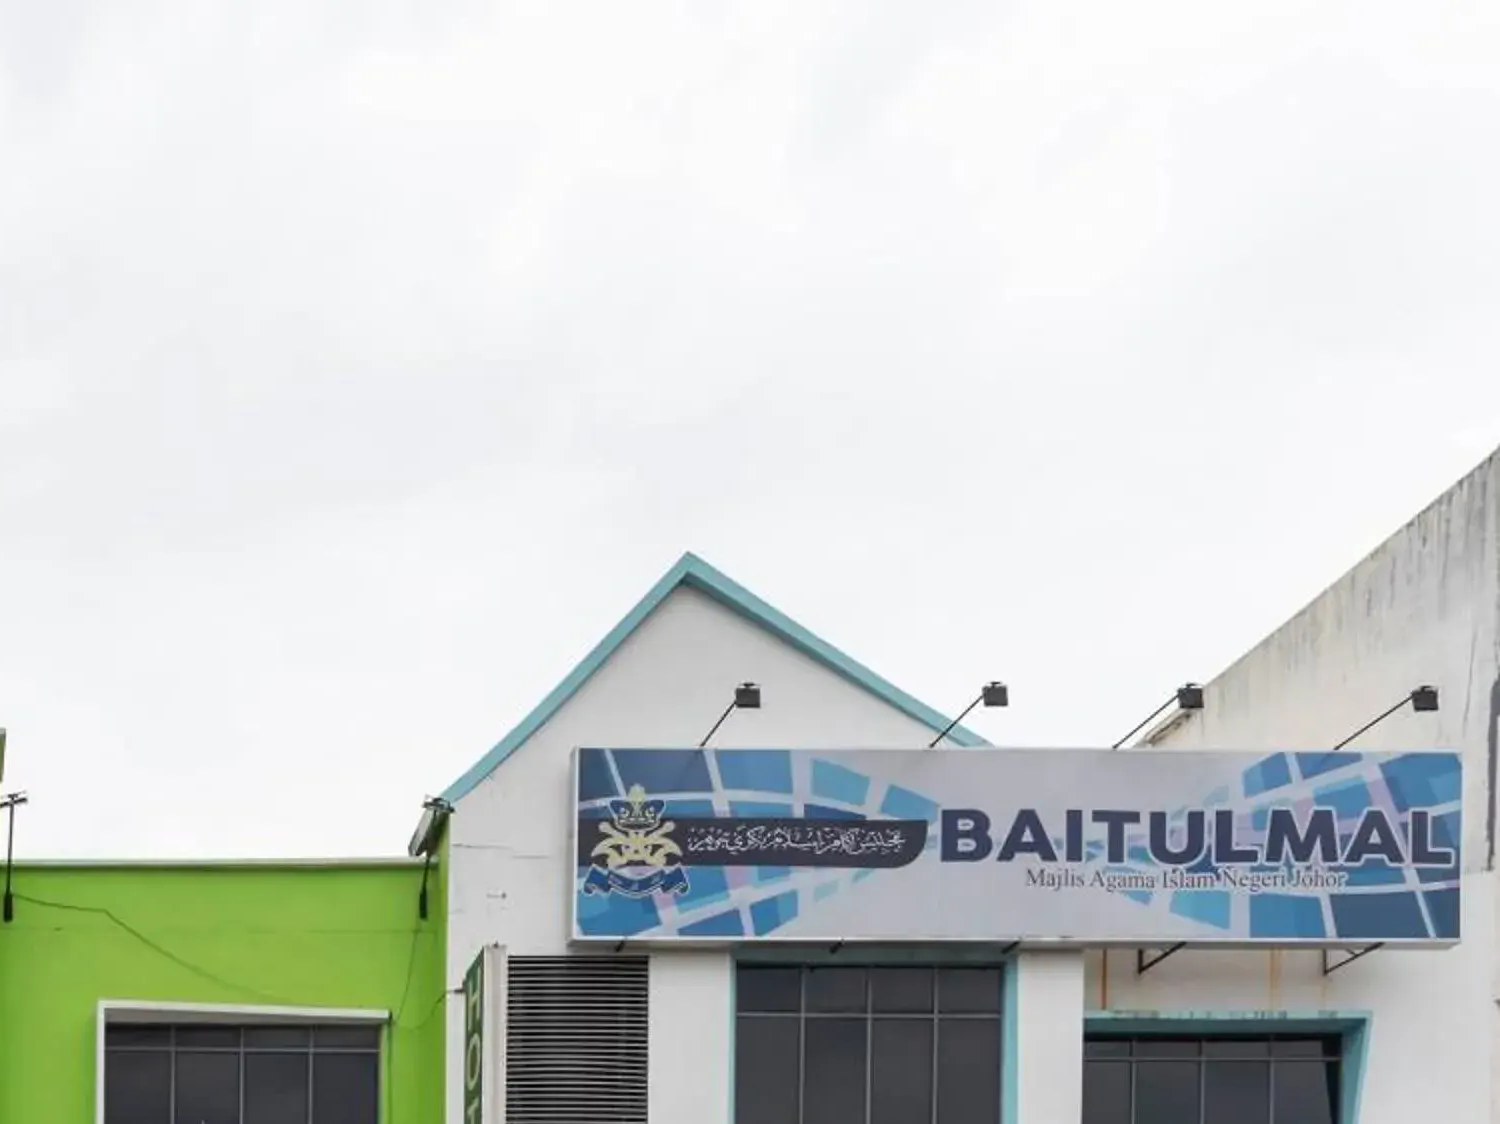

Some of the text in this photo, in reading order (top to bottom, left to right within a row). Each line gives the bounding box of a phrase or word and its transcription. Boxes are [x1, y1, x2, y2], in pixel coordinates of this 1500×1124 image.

[940, 808, 1453, 866] BAITULMAL
[1026, 868, 1347, 891] Majlis Agama Islam Negeri Johor
